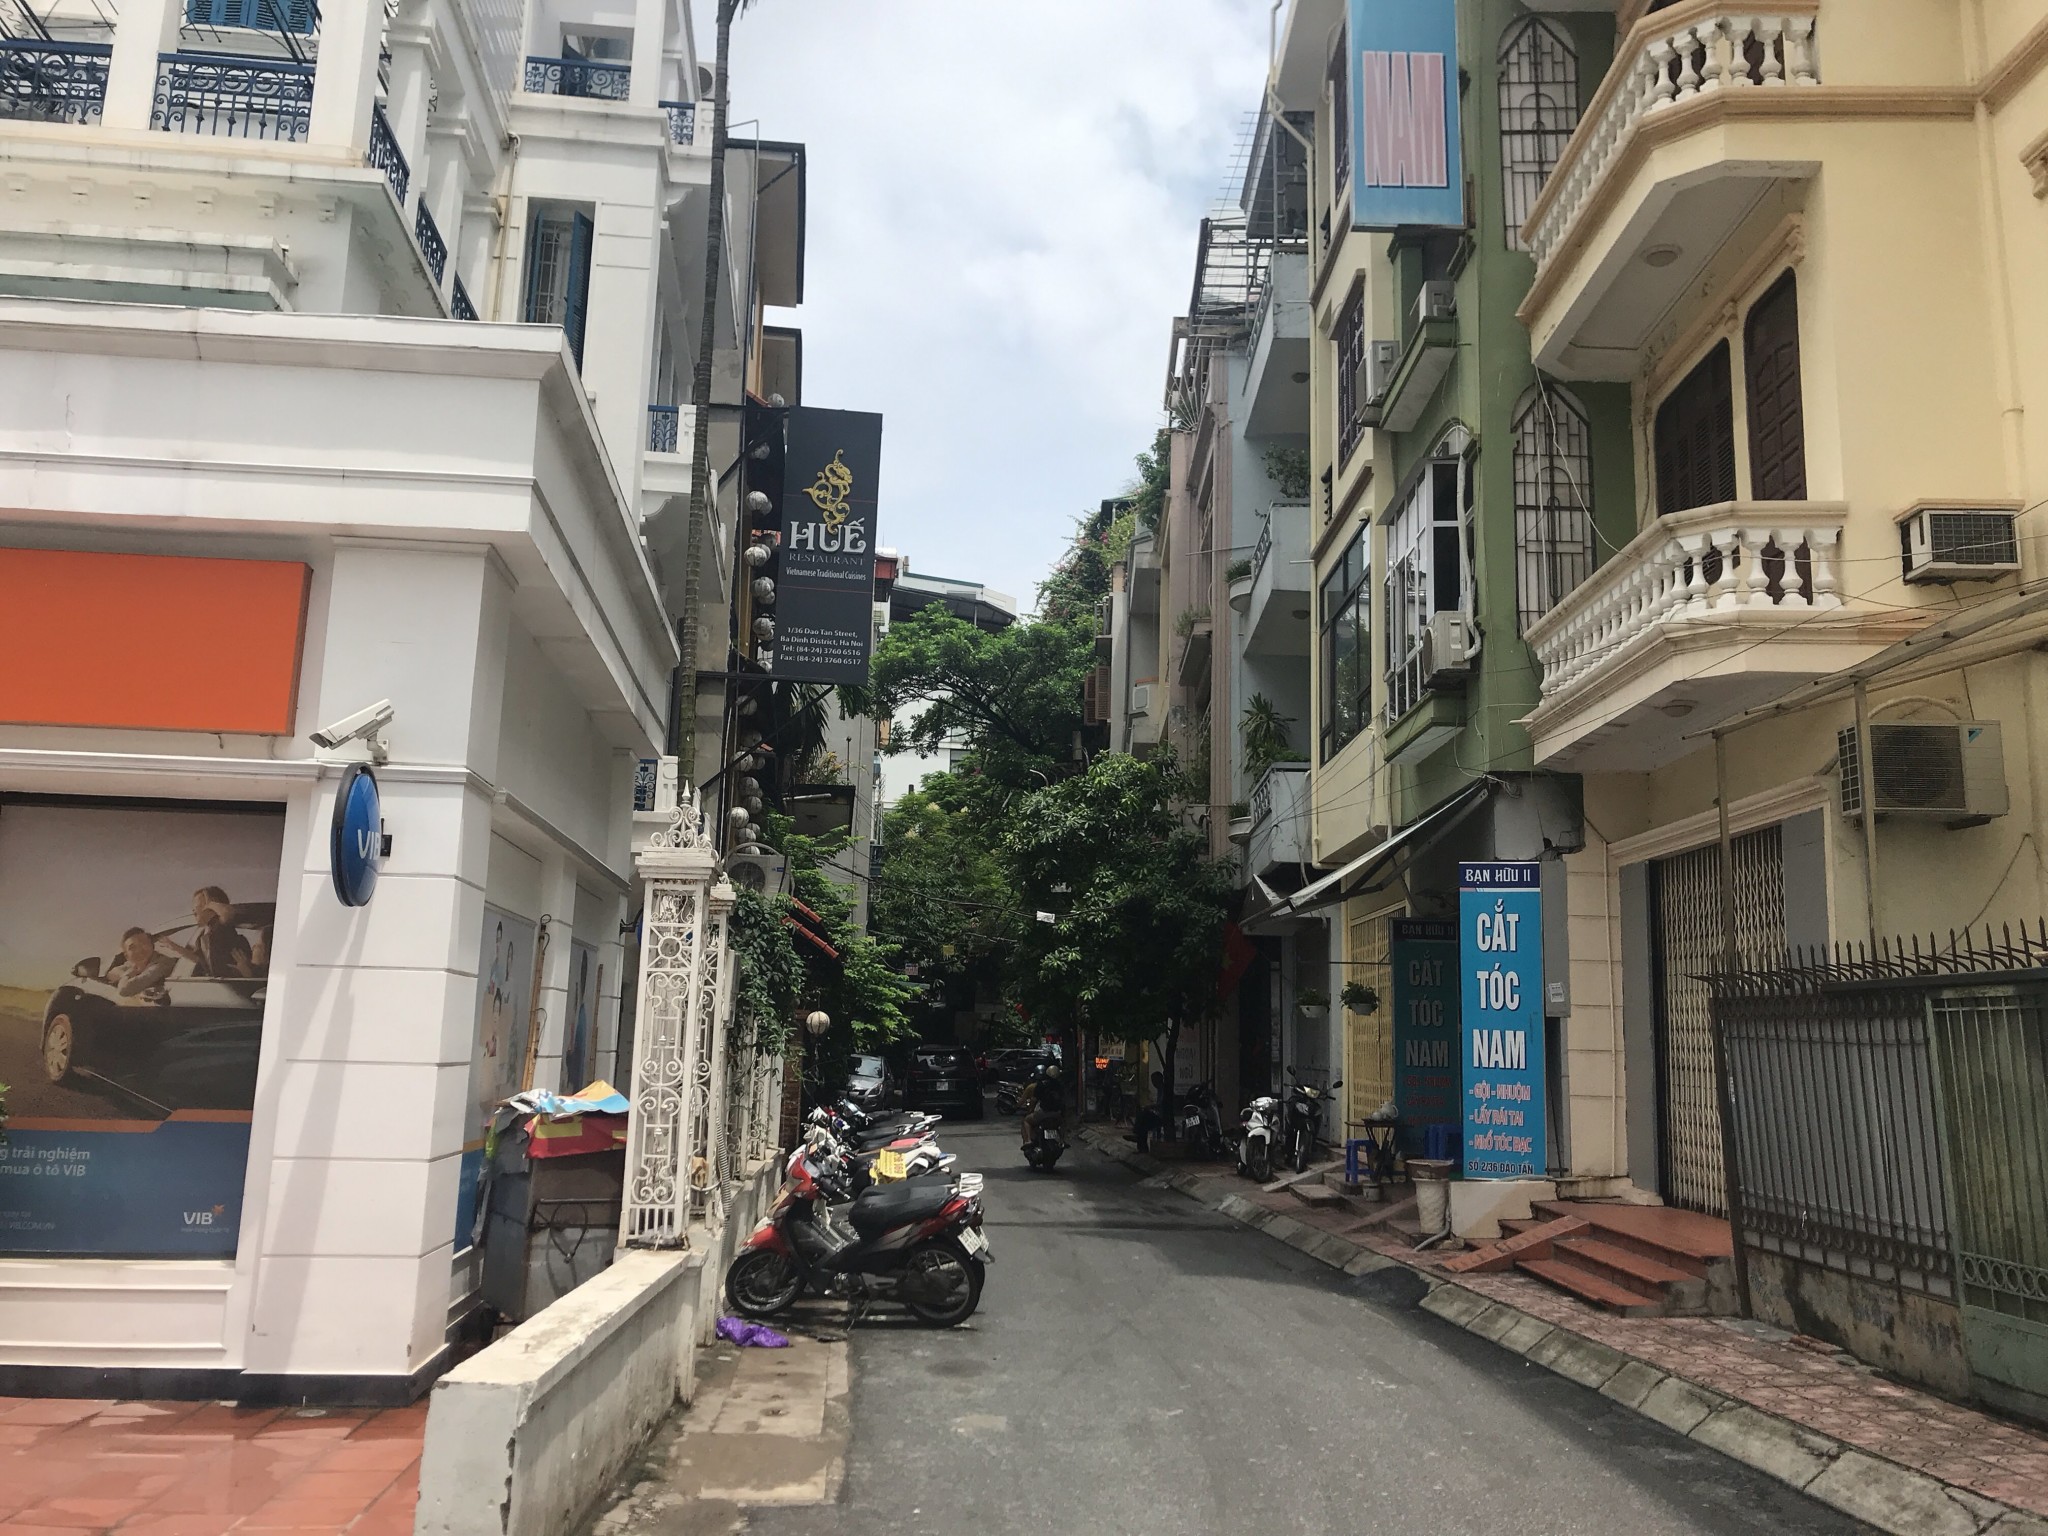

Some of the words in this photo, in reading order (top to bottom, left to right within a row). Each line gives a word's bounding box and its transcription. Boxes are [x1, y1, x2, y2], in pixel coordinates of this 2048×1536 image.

[1362, 50, 1447, 188] NAM
[789, 517, 866, 553] HUẾ
[789, 552, 864, 566] RESTAURANT
[786, 567, 816, 577] Vietnamese
[817, 568, 844, 579] Traditional
[845, 571, 866, 580] Cuisines
[810, 637, 838, 646] District,
[834, 629, 858, 638] Street,
[796, 645, 822, 654] (84-24)
[780, 653, 795, 661] Fax:
[796, 655, 822, 663] (84-24)
[824, 656, 842, 664] 3760
[358, 829, 381, 860] VIB
[1465, 869, 1490, 884] BẠN
[1495, 867, 1518, 882] HỮU
[1523, 869, 1531, 882] II
[1477, 899, 1519, 951] CẮT
[1409, 950, 1443, 986] CẮT
[1476, 963, 1520, 1010] TÓC
[1408, 994, 1444, 1027] TÓC
[1405, 1040, 1448, 1067] NAM
[1472, 1029, 1526, 1069] NAM
[1474, 1080, 1490, 1102] GỘI
[1509, 1111, 1524, 1127] TAI
[1494, 1132, 1512, 1151] TÓC
[1513, 1137, 1532, 1156] BẠC
[38, 1147, 90, 1163] nghiệm
[0, 1165, 29, 1175] mua
[33, 1163, 43, 1175] ô
[63, 1164, 86, 1177] VIB
[1481, 1161, 1498, 1172] 2/36
[183, 1211, 213, 1225] VIB
